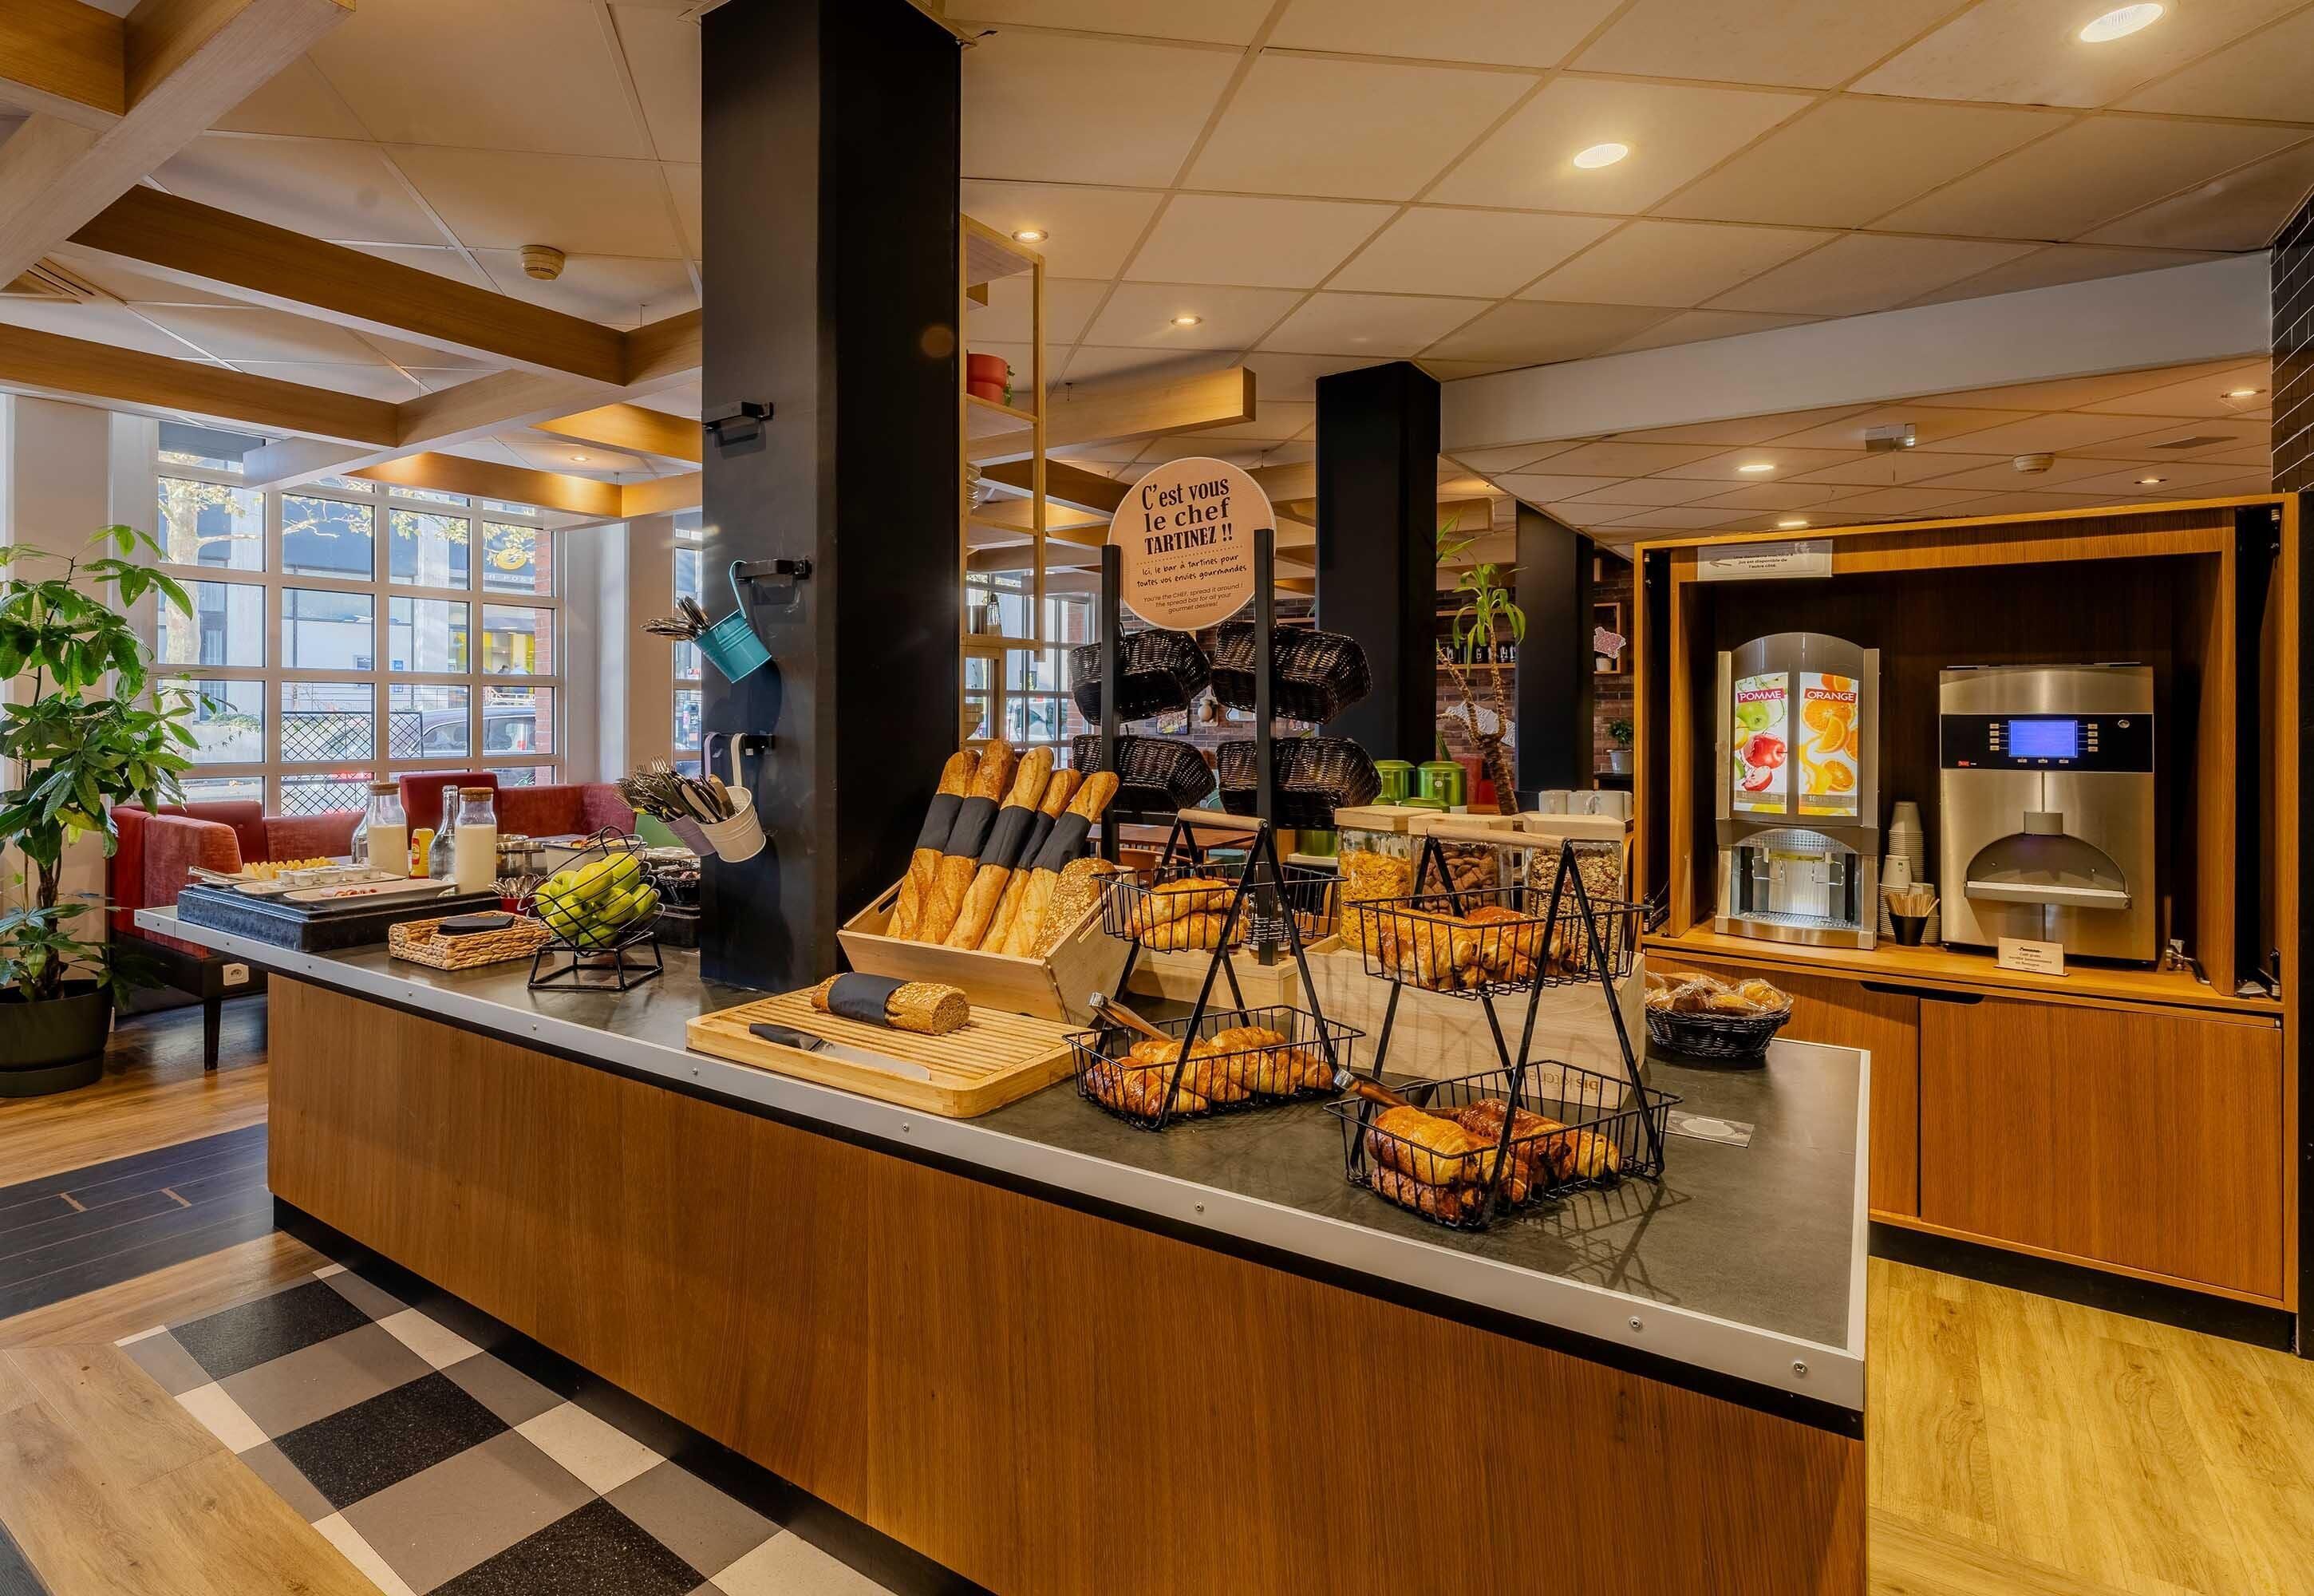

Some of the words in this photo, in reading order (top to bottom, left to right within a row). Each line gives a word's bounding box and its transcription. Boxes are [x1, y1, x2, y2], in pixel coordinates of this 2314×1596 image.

[1142, 484, 1183, 511] C'est
[1188, 479, 1230, 501] vous
[1144, 513, 1166, 532] le
[1175, 497, 1230, 527] chef
[1144, 526, 1217, 555] TARTINEZ
[1222, 523, 1232, 542] !!
[1180, 560, 1185, 569] à
[1187, 558, 1218, 568] tartines
[1221, 555, 1239, 565] pour
[1136, 579, 1158, 588] toutes
[1175, 573, 1196, 582] envies
[1198, 564, 1246, 580] gourmandes
[1190, 587, 1211, 596] spread
[1217, 583, 1240, 591] around
[1167, 598, 1187, 607] spread
[1168, 604, 1194, 614] gourmet
[1739, 690, 1782, 701] POMME
[1807, 691, 1855, 701] ORANGE
